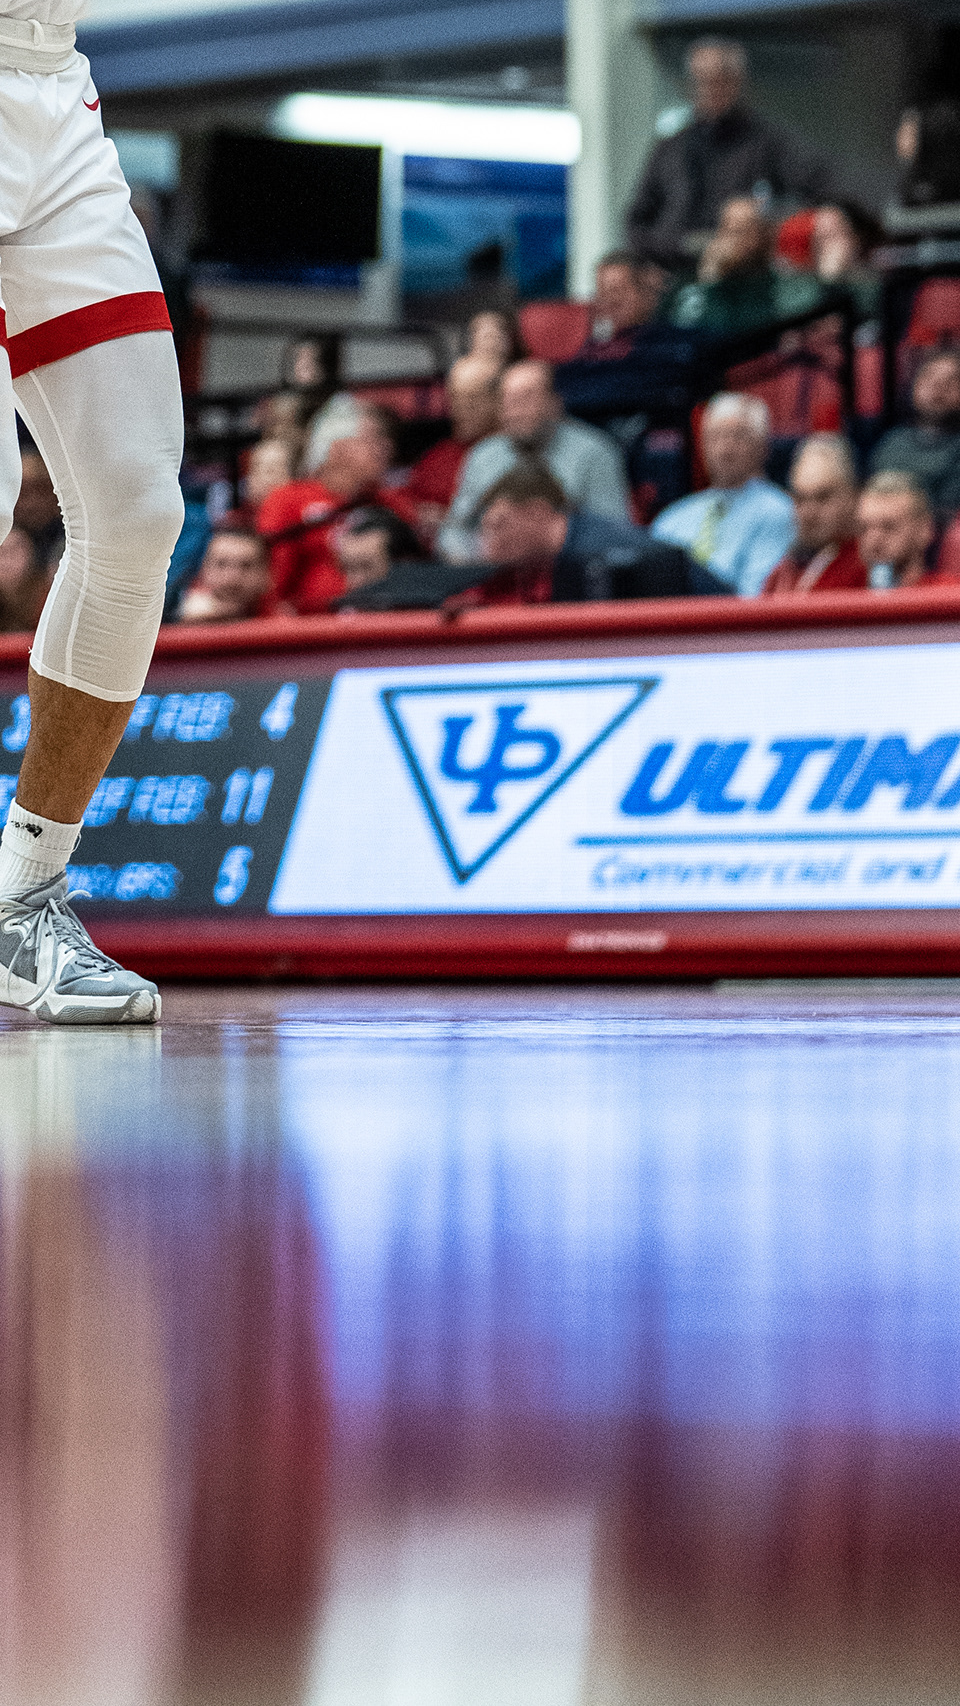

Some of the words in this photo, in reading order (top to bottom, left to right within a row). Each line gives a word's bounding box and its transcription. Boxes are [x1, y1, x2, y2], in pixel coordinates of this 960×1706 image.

[260, 682, 299, 742] 4
[440, 703, 561, 814] UP
[221, 766, 275, 825] 11
